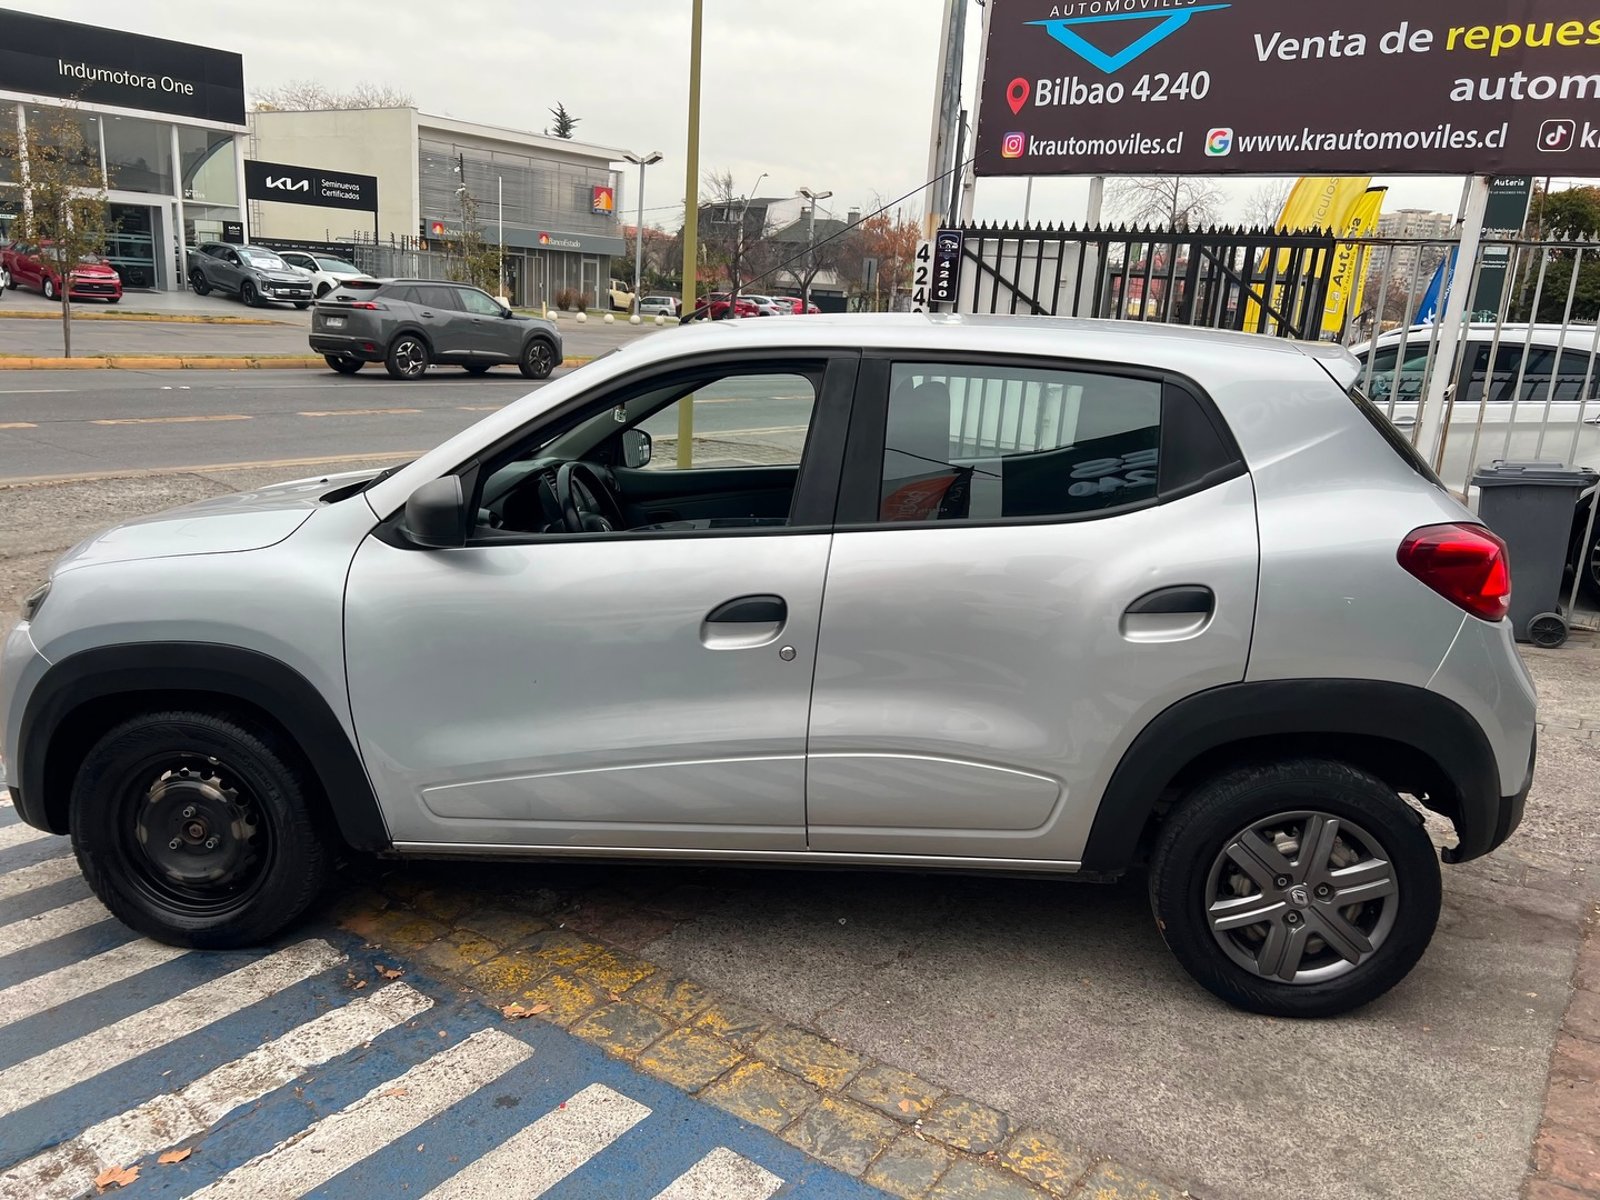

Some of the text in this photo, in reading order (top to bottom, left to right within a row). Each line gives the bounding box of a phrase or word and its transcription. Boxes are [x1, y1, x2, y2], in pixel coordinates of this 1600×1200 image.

[1253, 29, 1367, 62] Venta
[1379, 21, 1434, 54] de
[58, 59, 194, 96] Indumotora One
[1034, 70, 1211, 107] Bilbao 4240
[1028, 131, 1184, 156] krautomoviles.cl
[1238, 122, 1508, 152] www.krautomoviles.cl
[321, 179, 360, 191] Seminuevos
[321, 189, 360, 200] Certificados
[548, 237, 581, 249] BancoEstado
[938, 261, 951, 298] 4240
